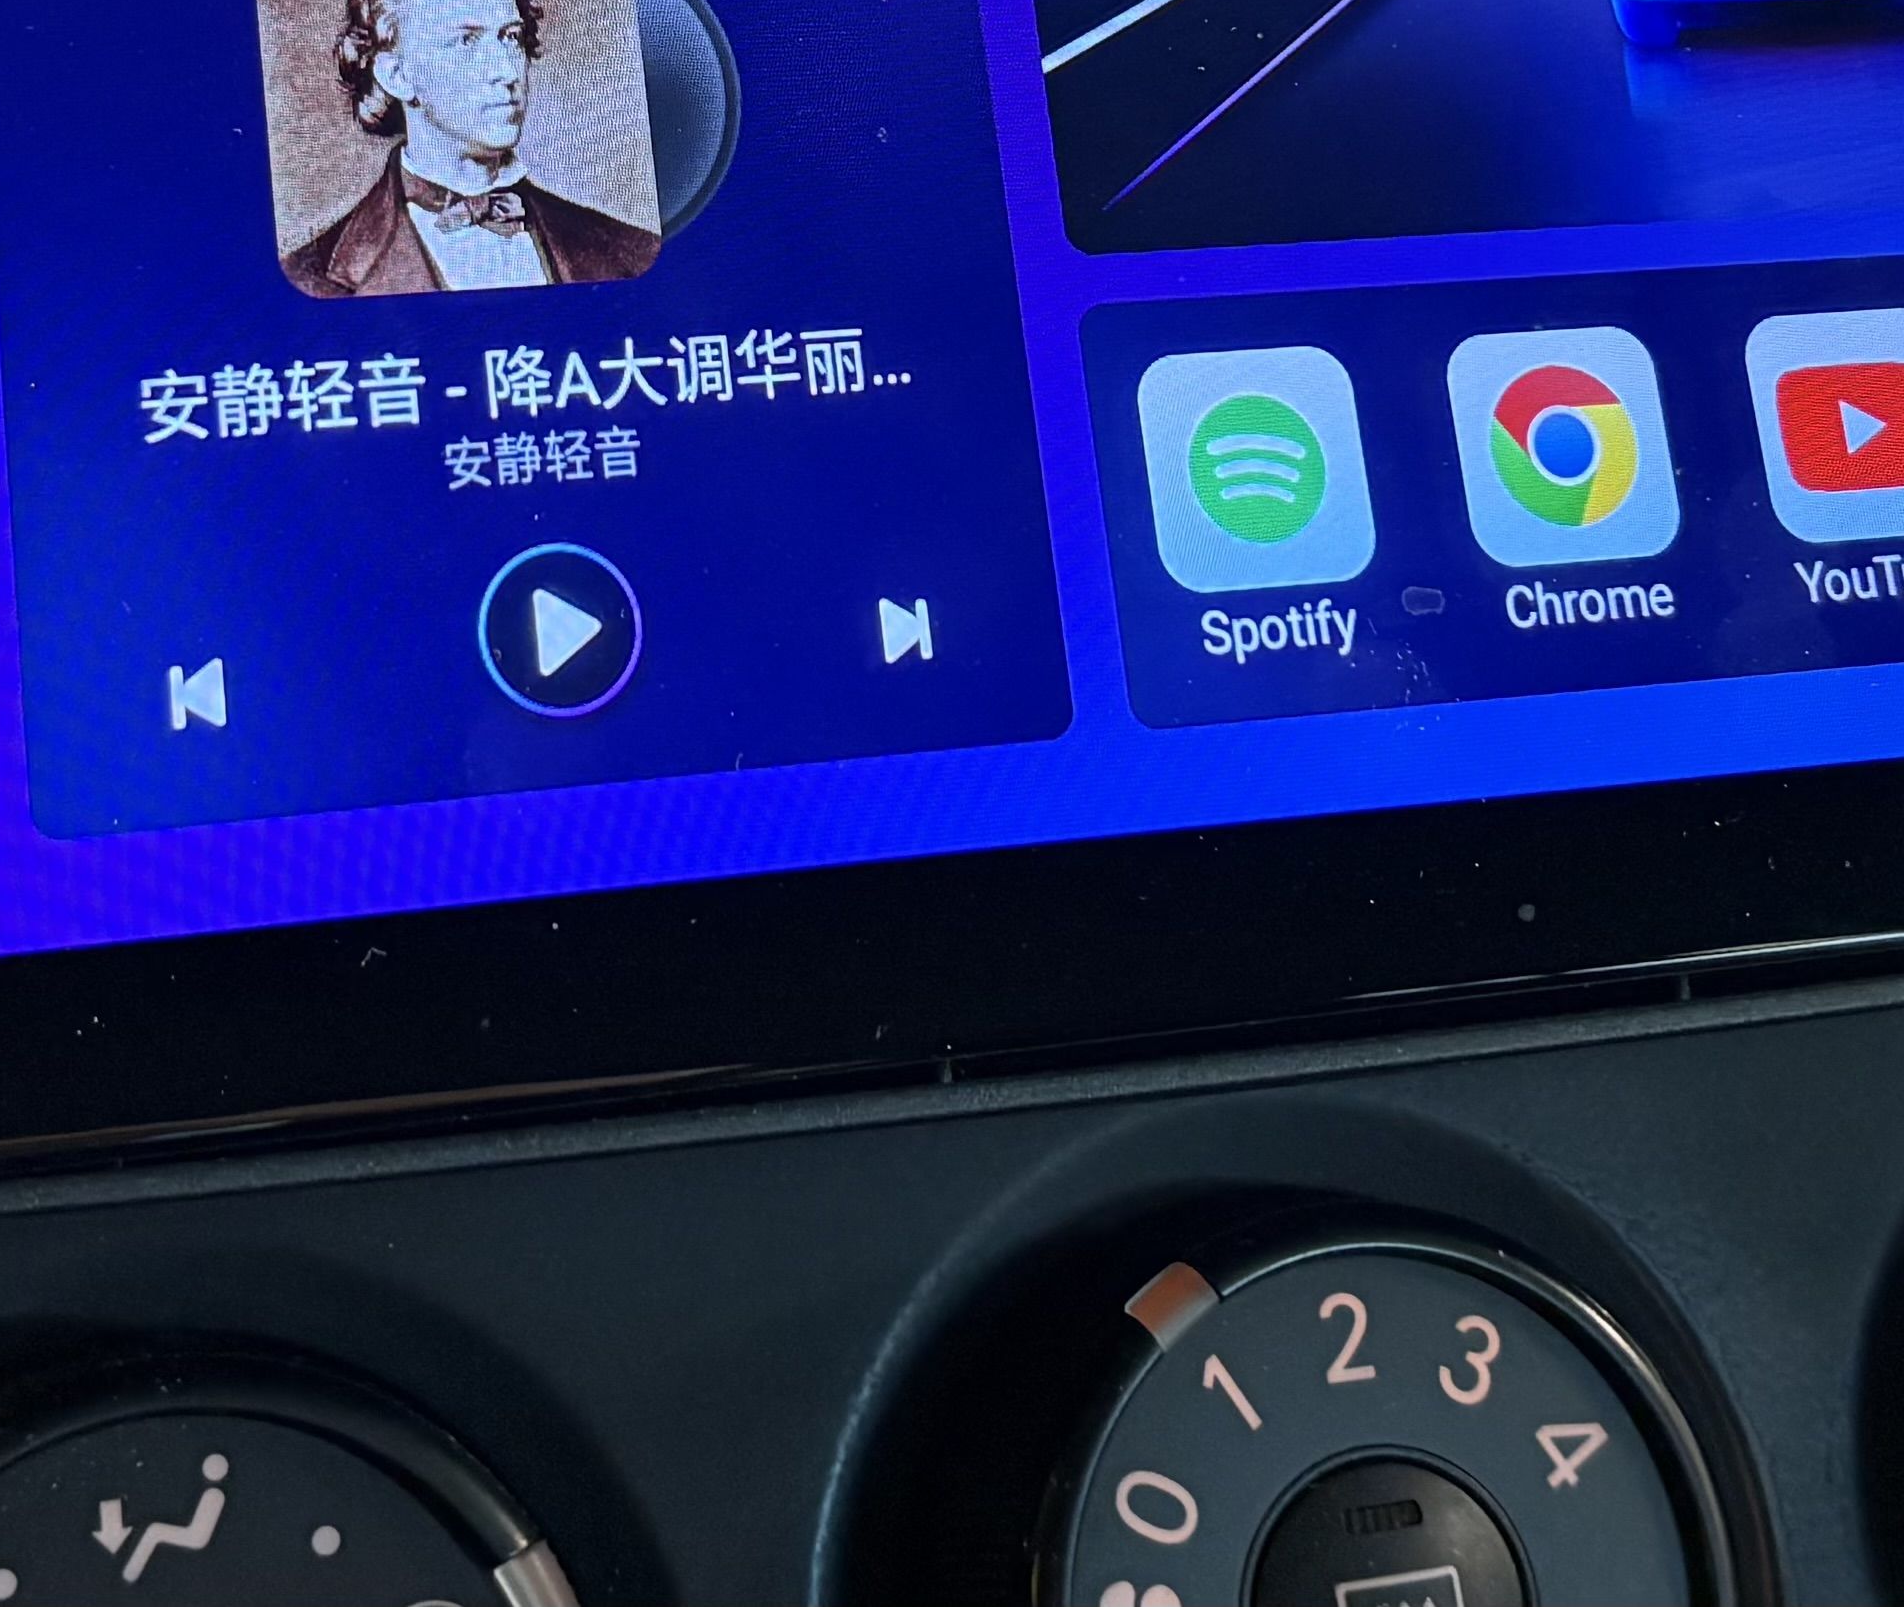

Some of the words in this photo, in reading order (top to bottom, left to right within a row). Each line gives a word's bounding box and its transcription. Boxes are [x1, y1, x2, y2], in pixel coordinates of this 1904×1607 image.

[139, 351, 425, 444] 安静轻音
[444, 425, 642, 490] 安静轻音
[1200, 596, 1358, 660] Spotify
[1504, 576, 1676, 630] Chrome
[1115, 1469, 1198, 1545] 0
[1202, 1354, 1263, 1431] 1
[1318, 1292, 1376, 1385] 2
[1438, 1314, 1500, 1406] 3
[1534, 1422, 1608, 1489] 4
